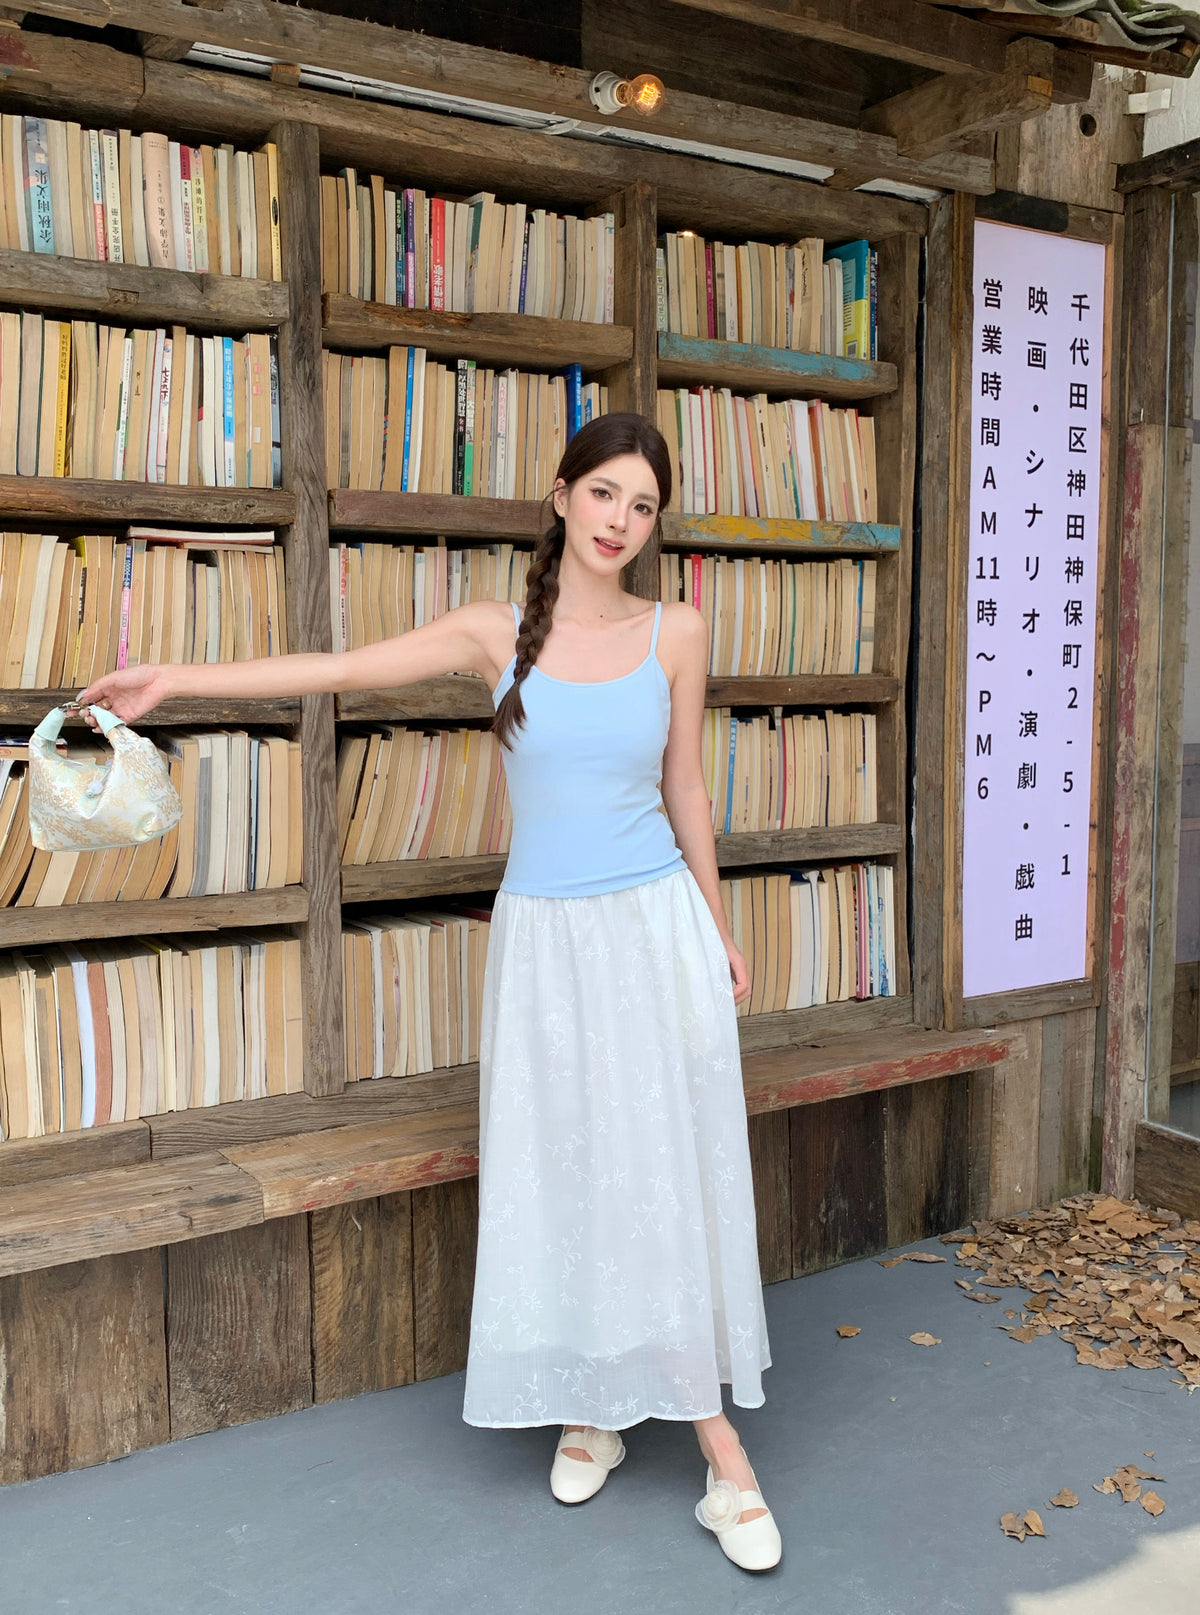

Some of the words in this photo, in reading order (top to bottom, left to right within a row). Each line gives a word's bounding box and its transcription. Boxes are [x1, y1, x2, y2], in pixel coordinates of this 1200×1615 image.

[35, 169, 52, 244] 余秋雨文集
[1014, 286, 1048, 941] 映画・シナリオ・演劇・戯曲
[1060, 294, 1090, 876] 千代田区神田神保町2-5-1
